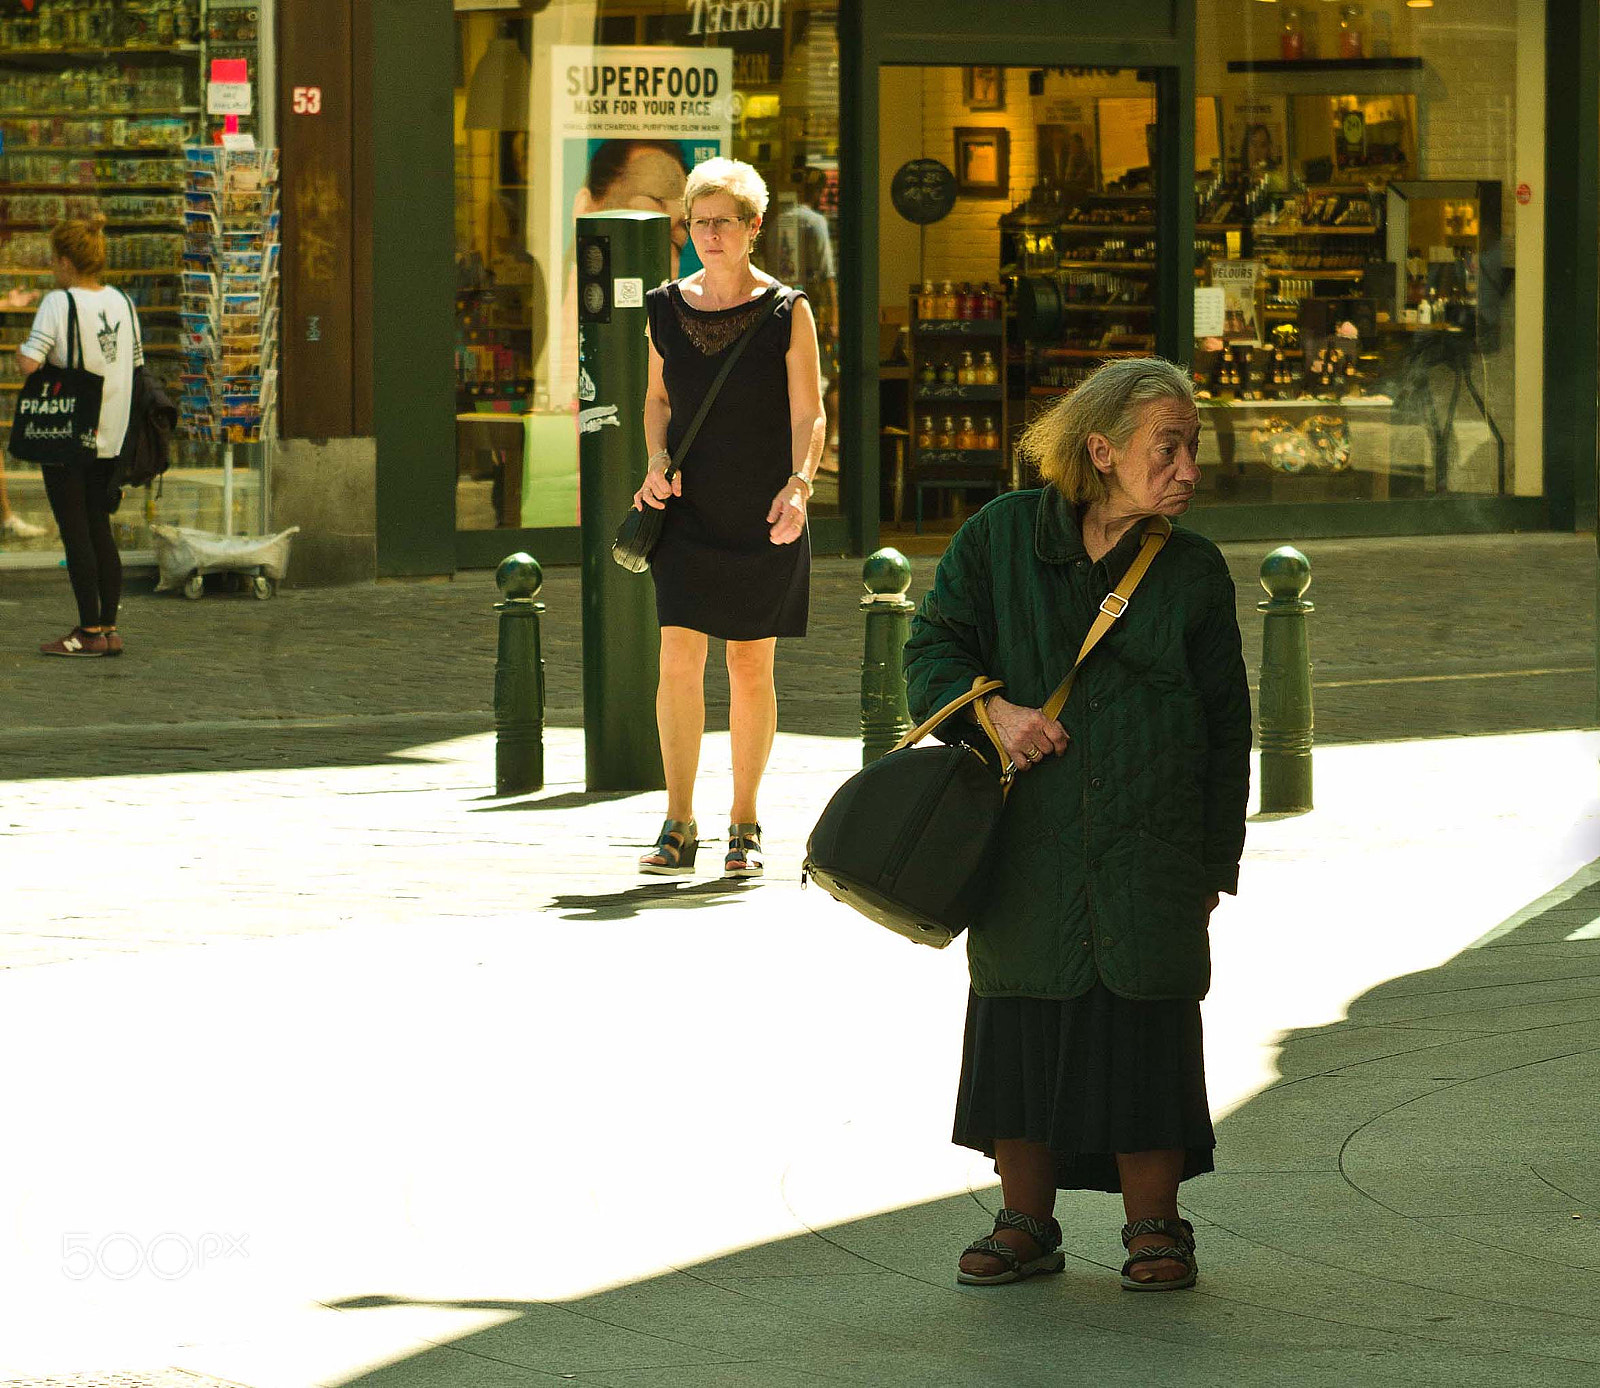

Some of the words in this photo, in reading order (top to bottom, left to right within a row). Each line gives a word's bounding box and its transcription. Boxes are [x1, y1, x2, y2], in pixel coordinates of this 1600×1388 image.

[566, 65, 718, 98] SUPERFOOD
[293, 86, 321, 114] 53
[574, 99, 608, 115] MASK
[613, 100, 637, 115] FOR
[643, 101, 675, 116] YOUR
[681, 101, 711, 116] FACE
[1212, 267, 1253, 279] VELOURS
